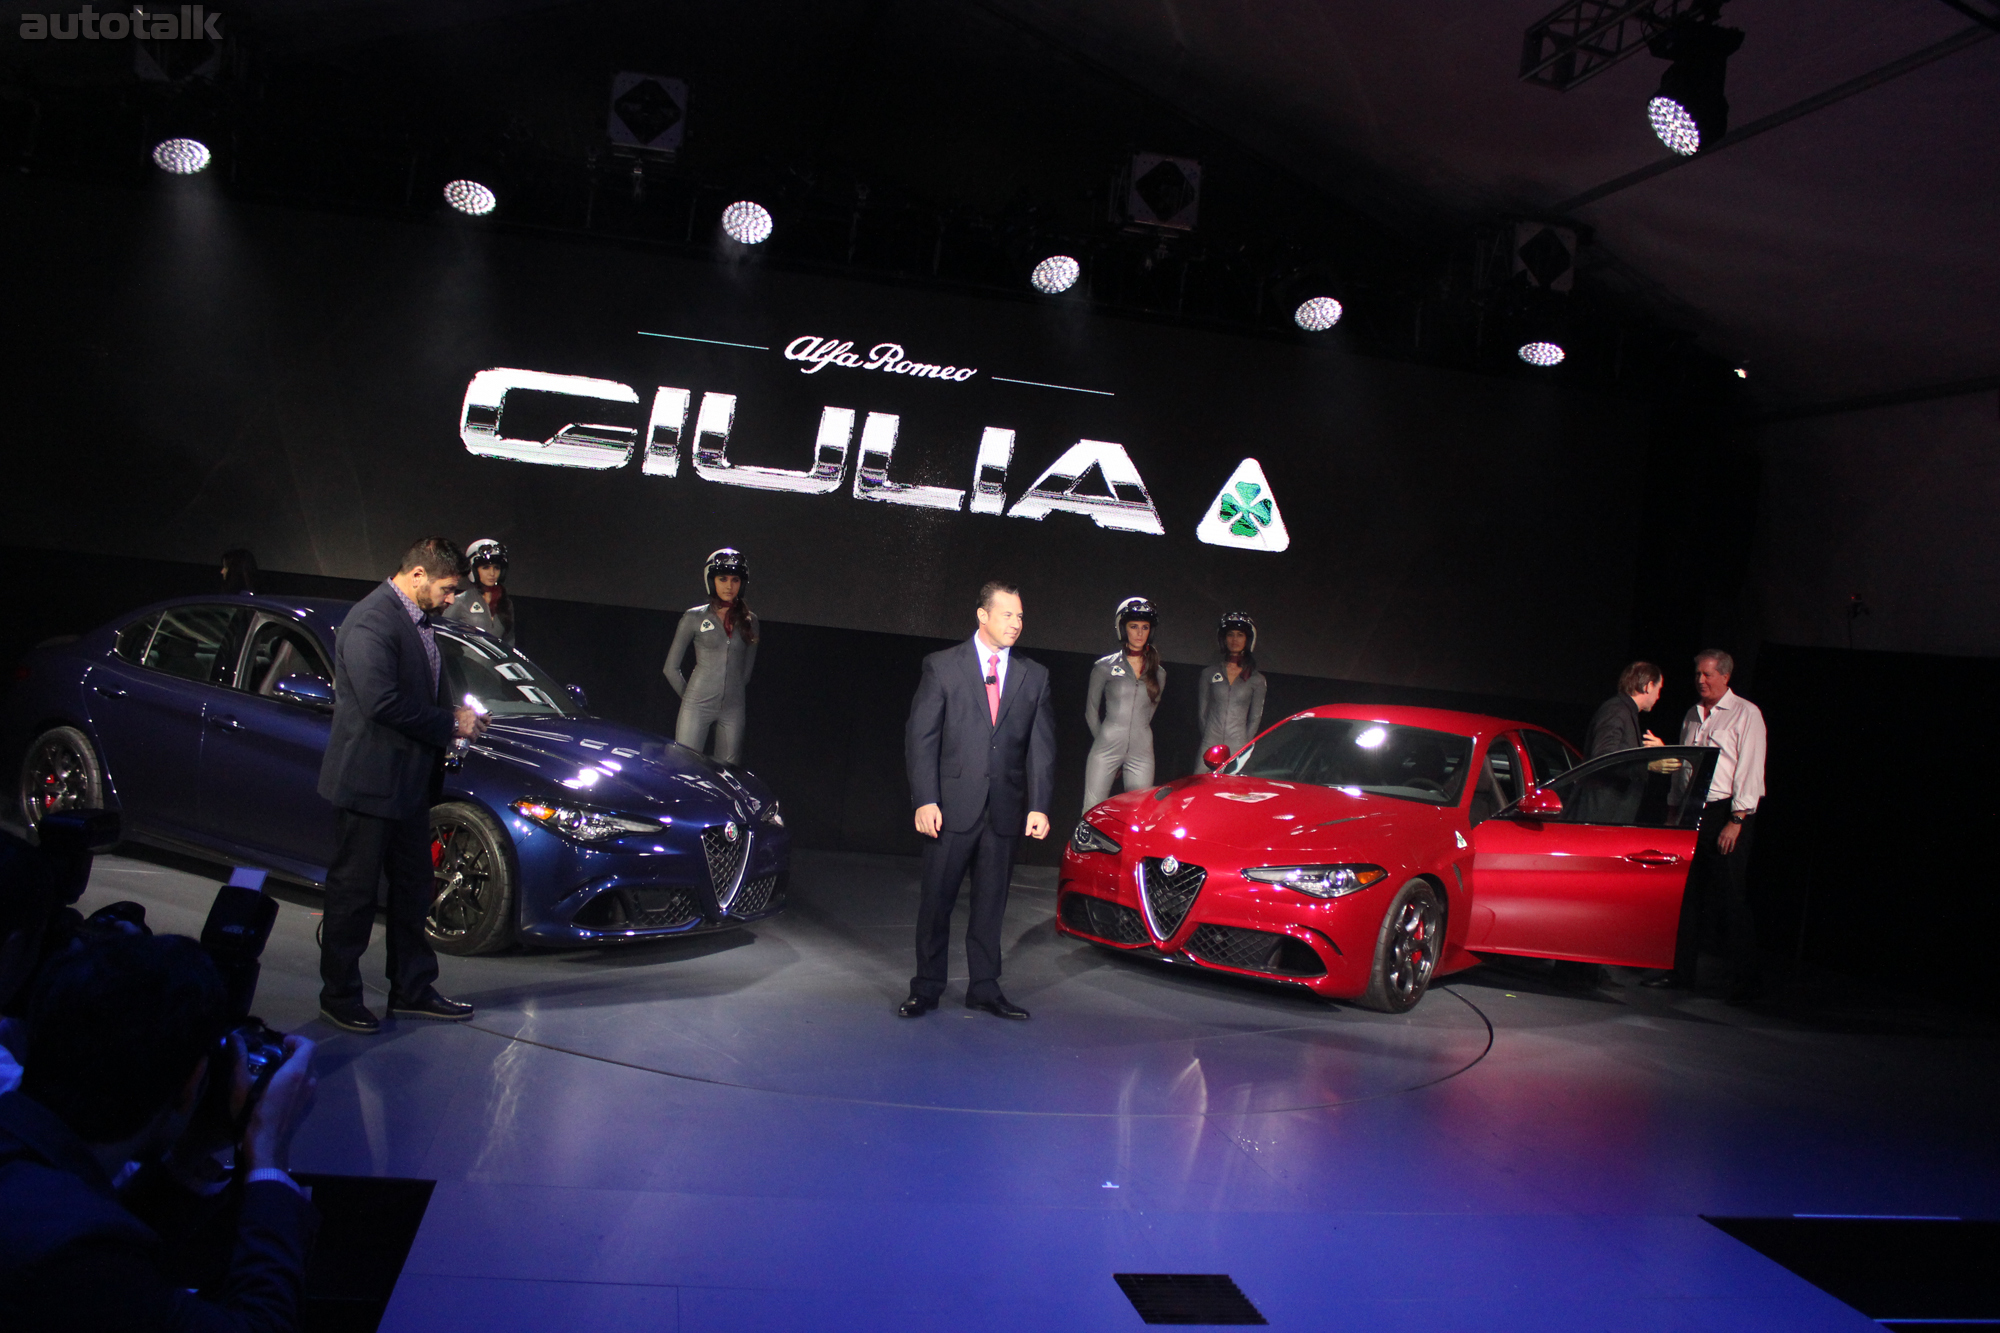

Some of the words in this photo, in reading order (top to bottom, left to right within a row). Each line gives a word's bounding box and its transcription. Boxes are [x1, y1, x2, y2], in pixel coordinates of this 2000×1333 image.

[784, 335, 864, 375] Alfa
[862, 342, 978, 382] Romeo
[459, 366, 1166, 536] GIULIA
